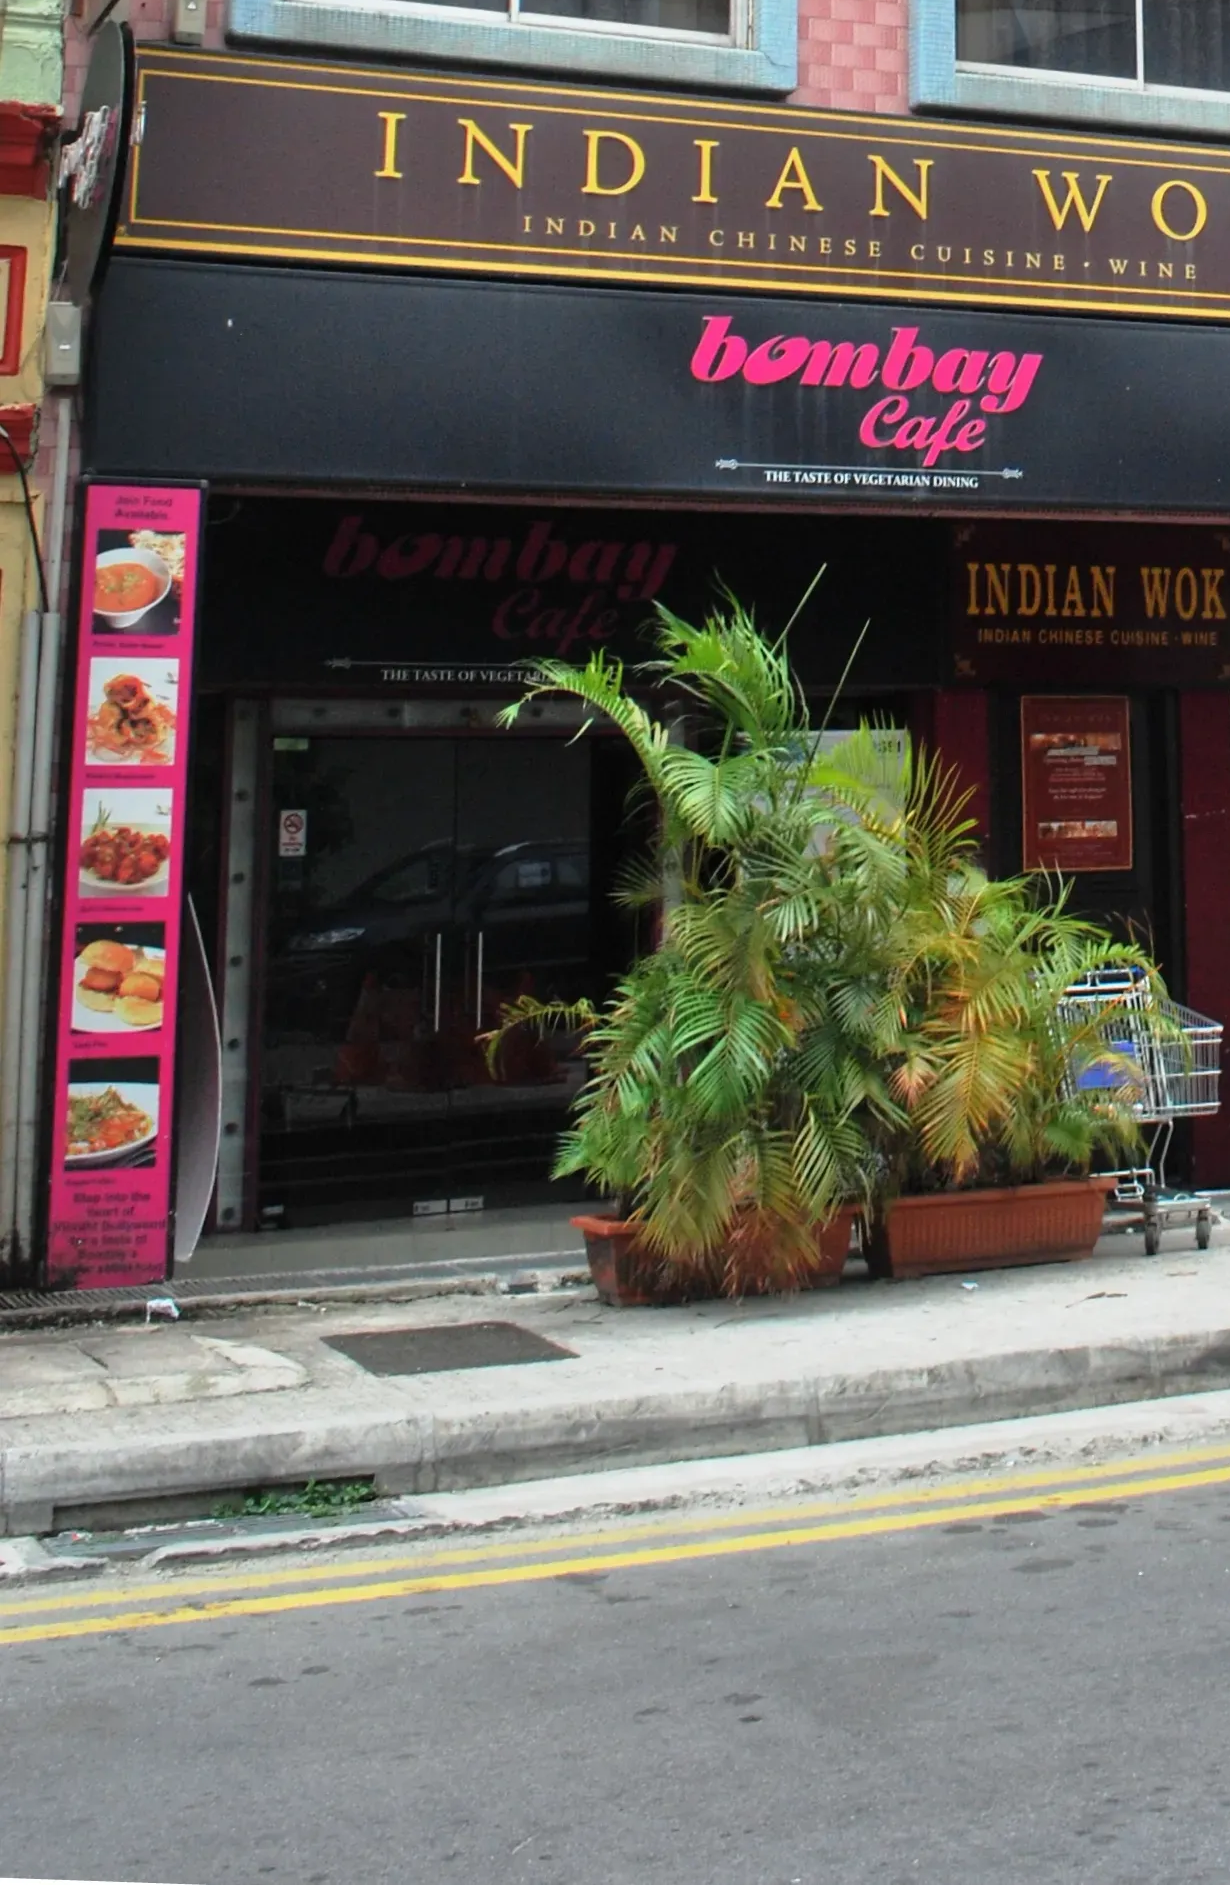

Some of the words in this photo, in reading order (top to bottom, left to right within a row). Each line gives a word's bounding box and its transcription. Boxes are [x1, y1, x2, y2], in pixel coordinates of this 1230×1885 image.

[374, 111, 935, 221] INDIAN
[523, 216, 680, 243] INDIAN
[708, 229, 883, 257] CHINESE
[910, 243, 1066, 271] CUISINE
[1108, 258, 1198, 280] WINE
[690, 315, 1044, 413] bombay
[859, 395, 987, 467] Cafe
[764, 470, 791, 483] THE
[793, 471, 832, 484] TASTE
[834, 473, 851, 485] OF
[853, 473, 931, 487] VEGETARIAN
[932, 475, 979, 488] DINING
[322, 514, 679, 602] bombay
[490, 588, 619, 656] Cafe
[966, 562, 1117, 618] INDIAN
[1140, 566, 1228, 621] WOK
[977, 628, 1031, 644] INDIAN
[1037, 628, 1104, 645] CHINESE
[1110, 630, 1169, 646] CUISINE
[1180, 631, 1218, 646] WINE
[381, 669, 408, 682] THE
[414, 669, 455, 682] TASTE
[458, 670, 476, 682] OF
[475, 670, 548, 683] VEGETARI
